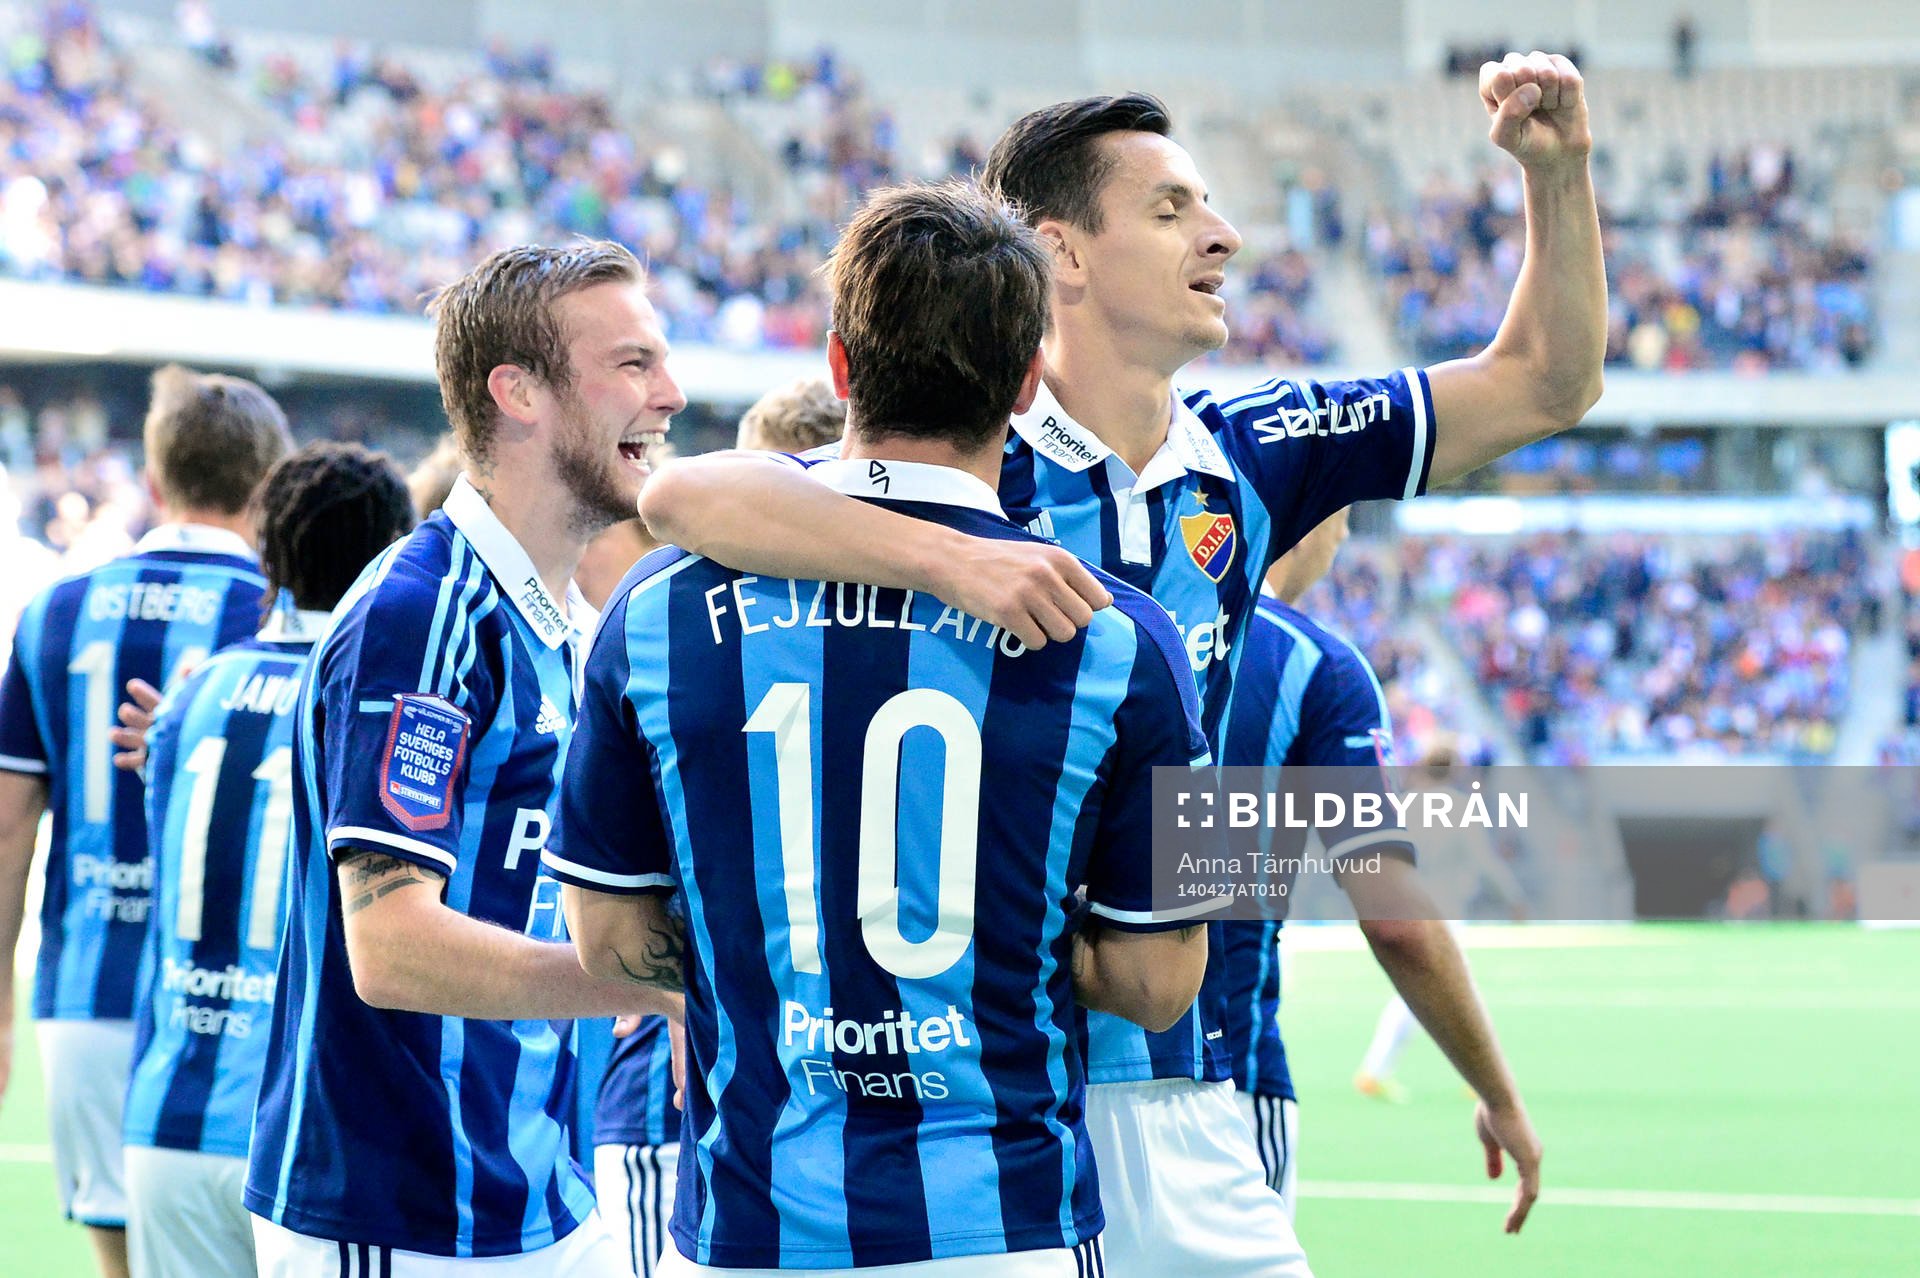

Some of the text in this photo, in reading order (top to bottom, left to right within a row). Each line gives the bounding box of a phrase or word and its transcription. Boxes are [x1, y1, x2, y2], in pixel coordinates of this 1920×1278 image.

[1041, 415, 1098, 462] Prioritet
[1252, 390, 1391, 445] stadium
[1038, 433, 1079, 463] Finans
[520, 591, 555, 636] Finans
[524, 577, 569, 634] Prioritet
[68, 640, 210, 823] 1
[399, 732, 454, 761] SVERIGES
[415, 722, 446, 742] HELA
[394, 745, 451, 775] FOTBOLLS
[400, 763, 437, 786] KLUBB
[177, 737, 293, 949] 11
[741, 682, 982, 979] 10
[73, 852, 153, 889] Priori
[784, 999, 970, 1055] Prioritet
[799, 1058, 949, 1100] Finans
